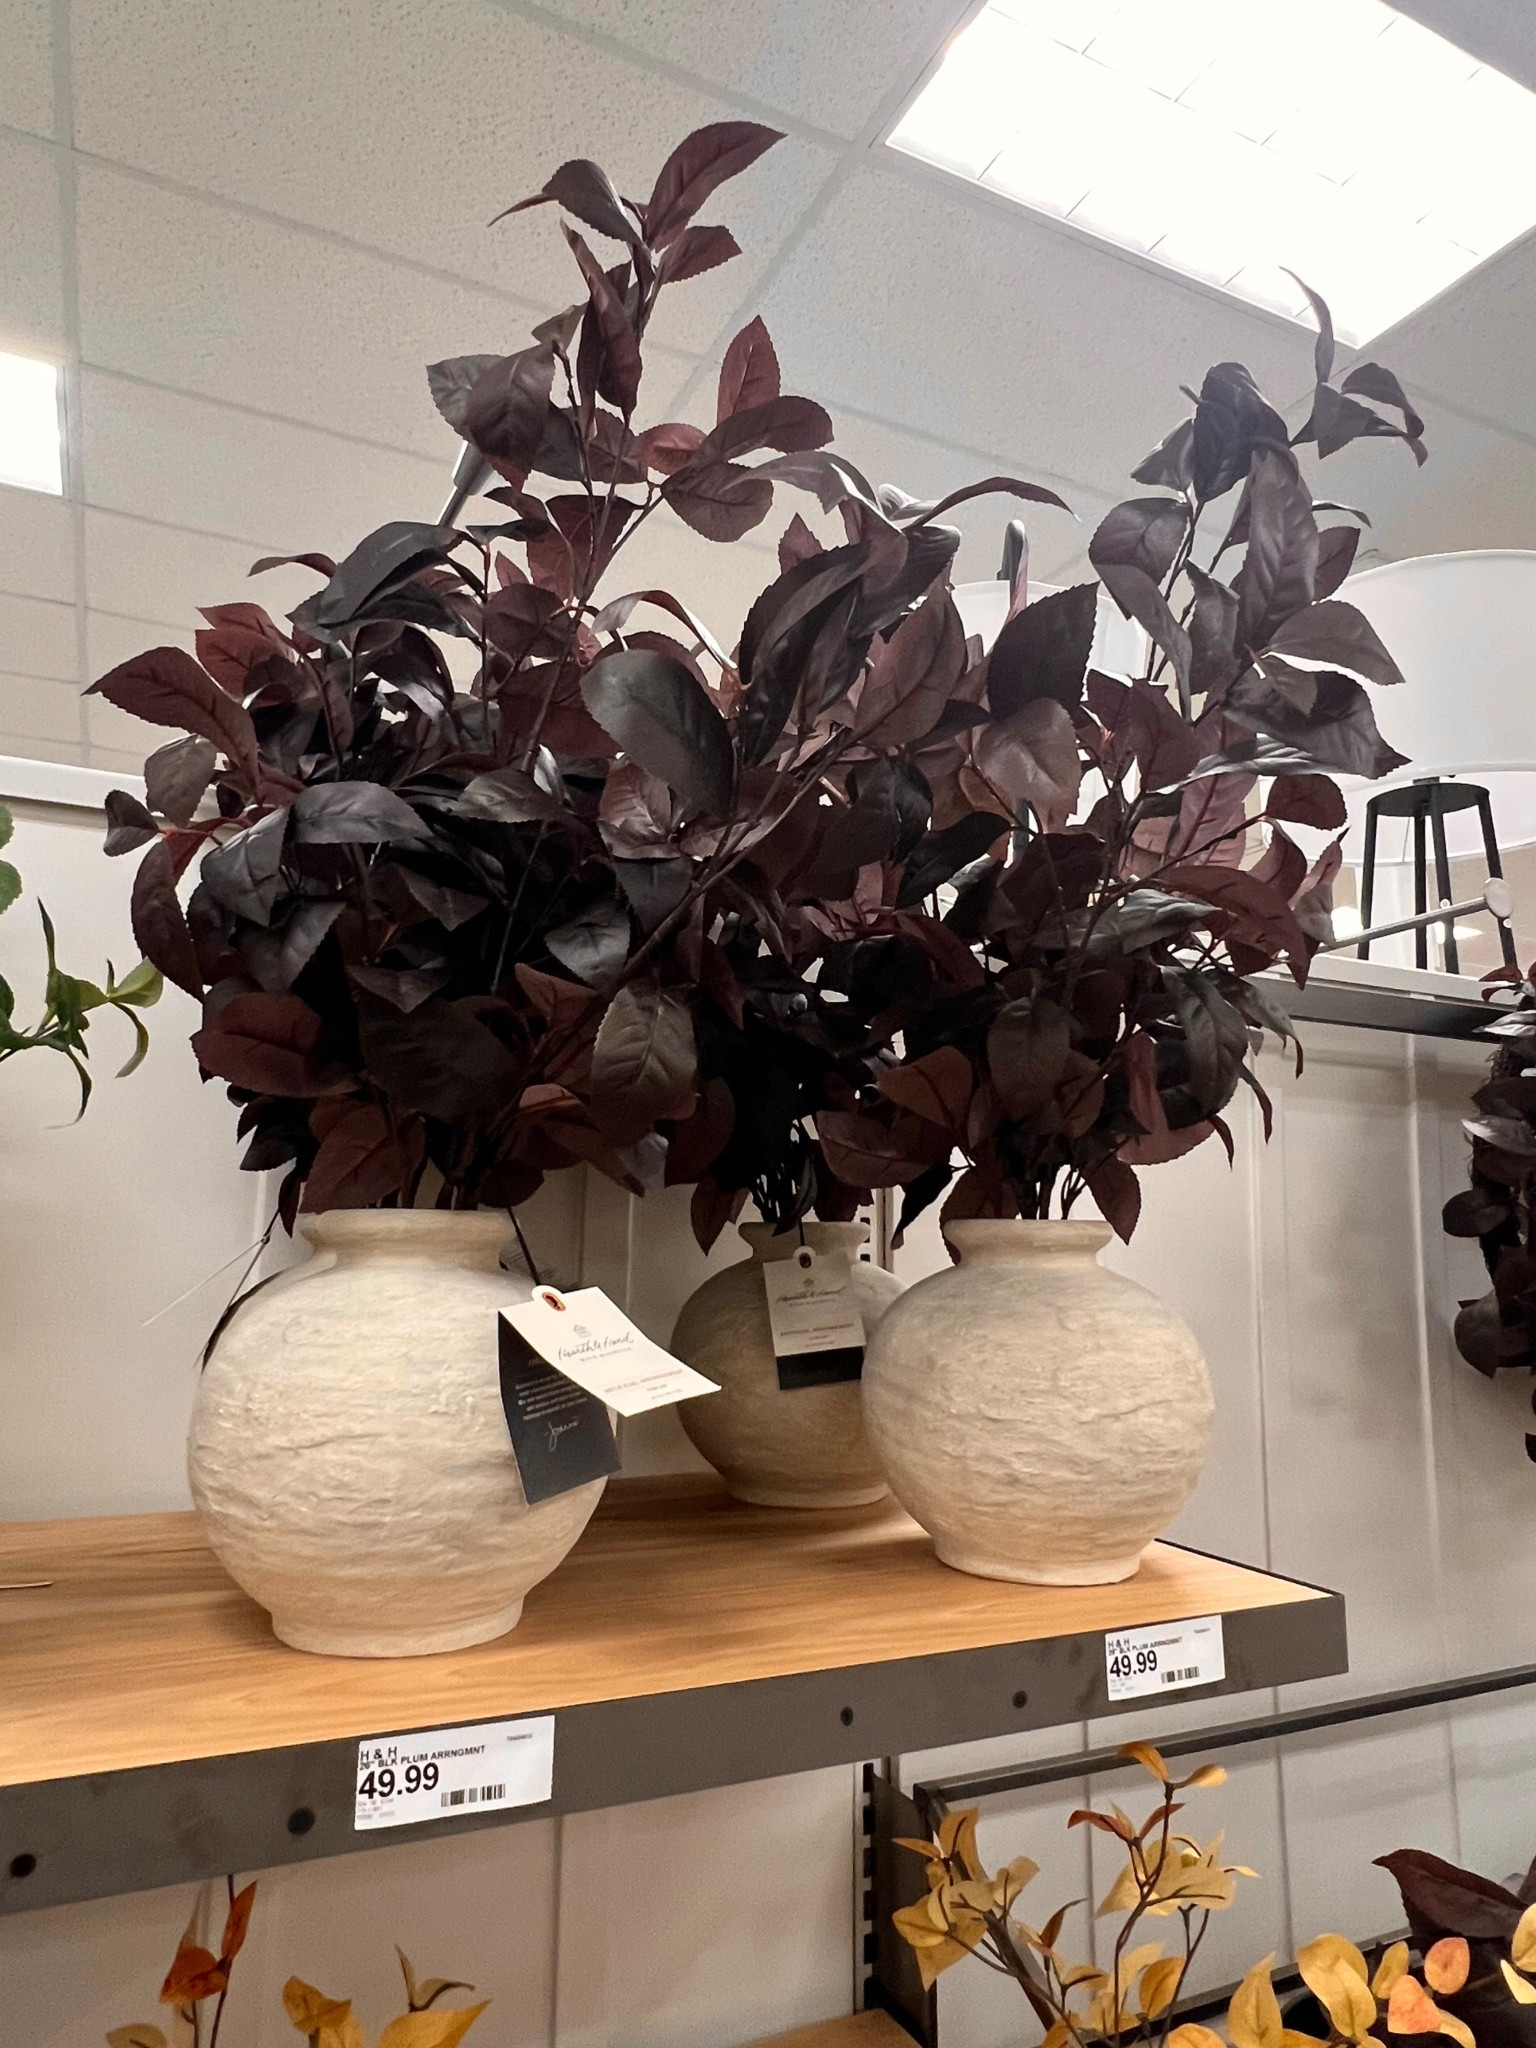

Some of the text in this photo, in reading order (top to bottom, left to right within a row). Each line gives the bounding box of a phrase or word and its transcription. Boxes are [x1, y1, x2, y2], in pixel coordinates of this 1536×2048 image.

[1110, 1649, 1157, 1677] 49.99
[360, 1746, 397, 1761] H & H
[401, 1753, 428, 1765] PLUM
[430, 1744, 485, 1761] ARRNGMNT
[358, 1762, 440, 1800] 49.99
